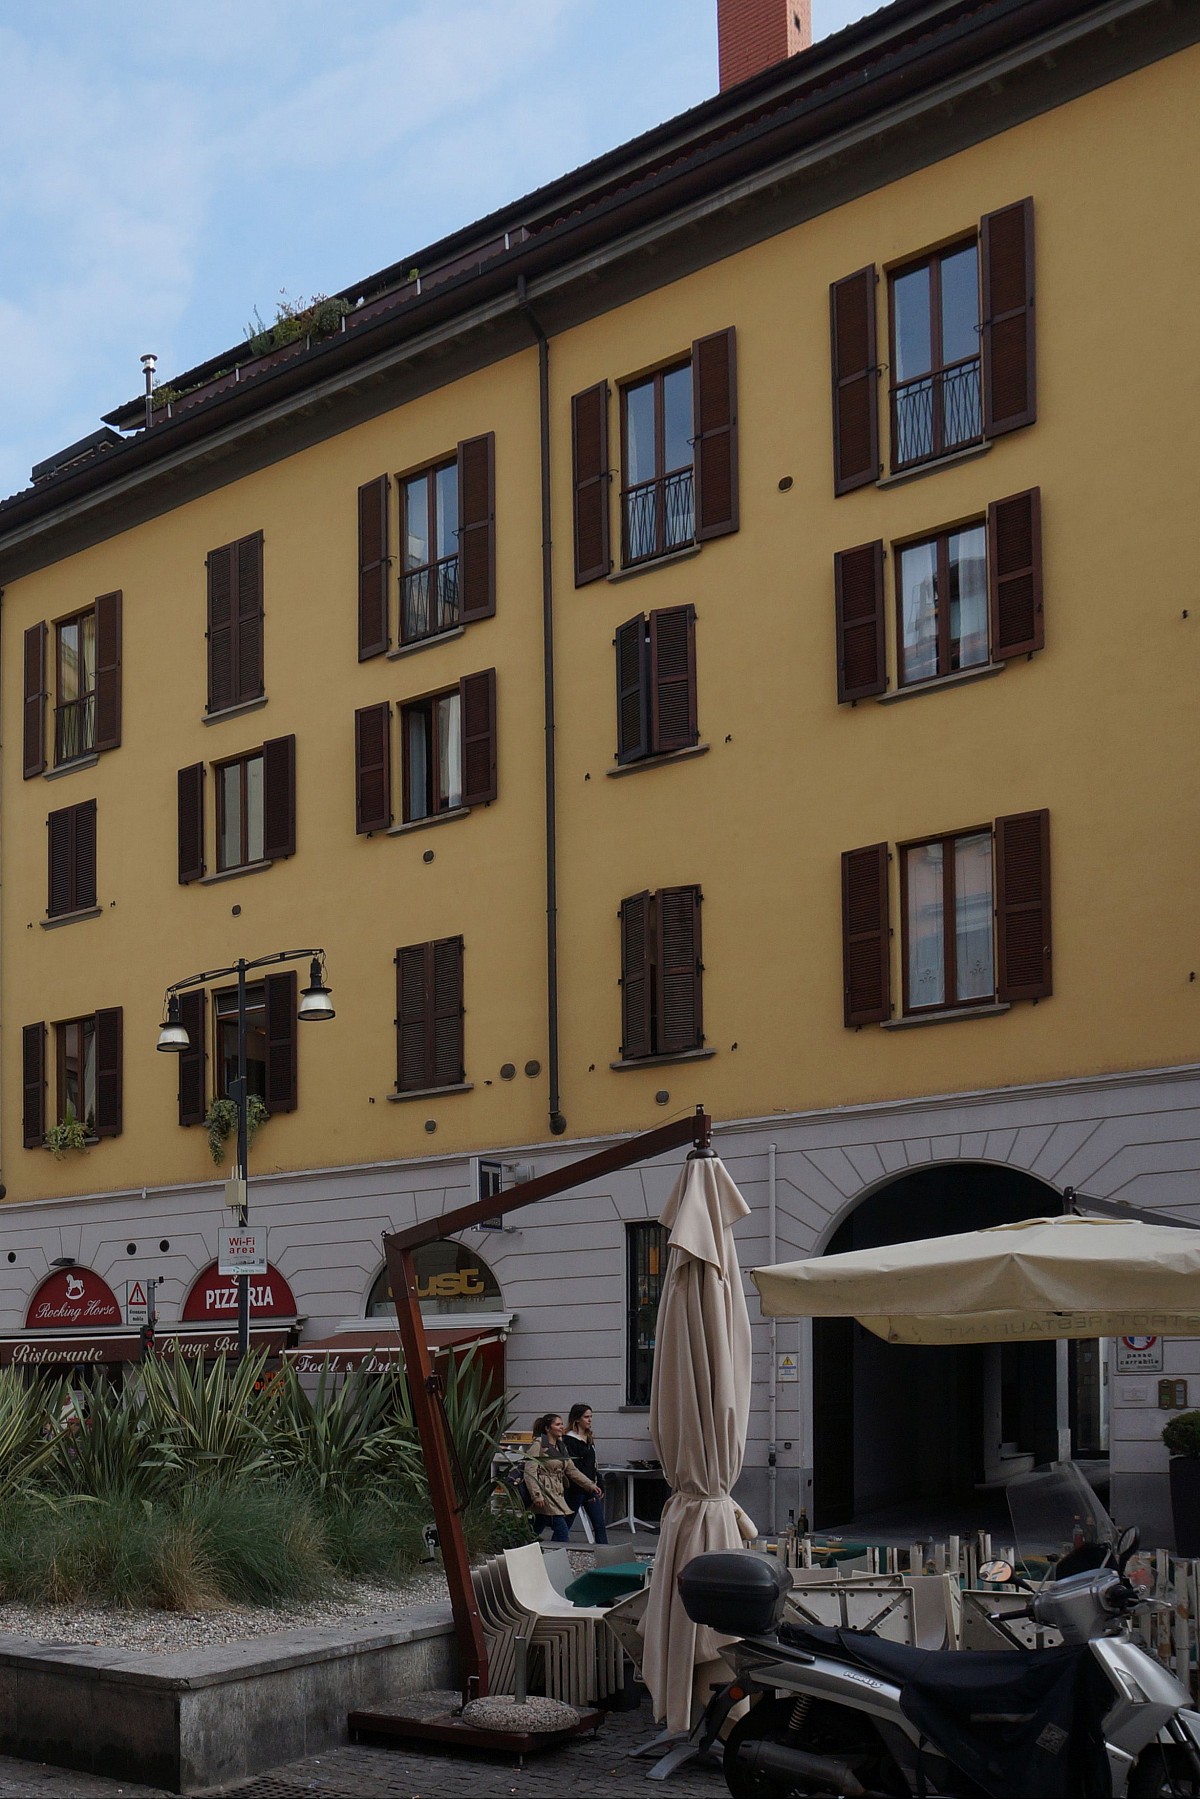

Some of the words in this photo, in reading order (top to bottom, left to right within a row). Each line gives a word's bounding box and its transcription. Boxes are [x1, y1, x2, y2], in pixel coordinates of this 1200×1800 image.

[228, 1236, 256, 1246] Wi-Fi
[229, 1246, 255, 1254] area
[387, 1268, 485, 1298] ust
[205, 1286, 274, 1310] PIZZRIA
[36, 1301, 81, 1322] Rocking
[83, 1299, 116, 1316] Horse
[11, 1343, 103, 1363] Ristorante
[156, 1337, 209, 1358] Lounge
[214, 1336, 239, 1352] Ba
[295, 1354, 340, 1373] Food
[1119, 1358, 1159, 1366] carrabile
